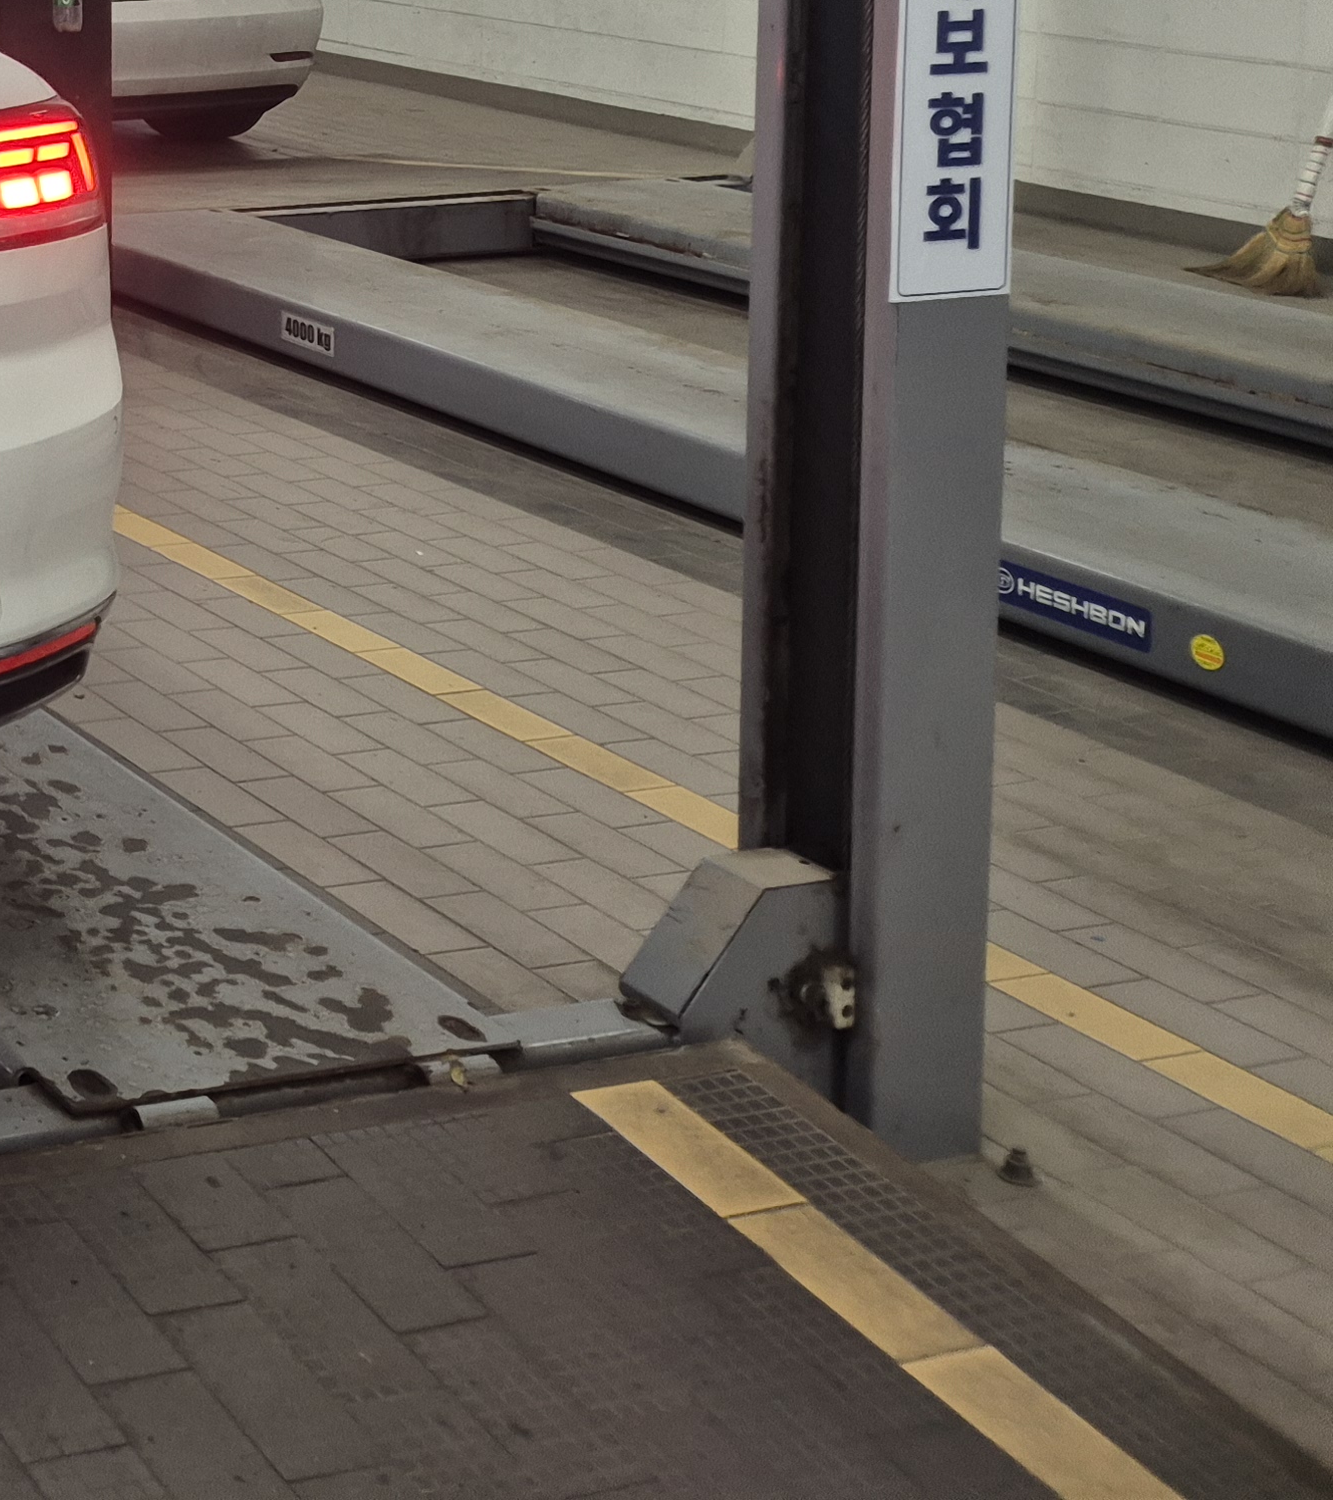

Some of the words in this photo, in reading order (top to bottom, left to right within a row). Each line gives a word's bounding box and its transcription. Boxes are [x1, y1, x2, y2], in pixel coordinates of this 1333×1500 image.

[285, 317, 315, 344] 4000
[317, 328, 331, 351] kg
[1017, 577, 1145, 638] HESHBON
